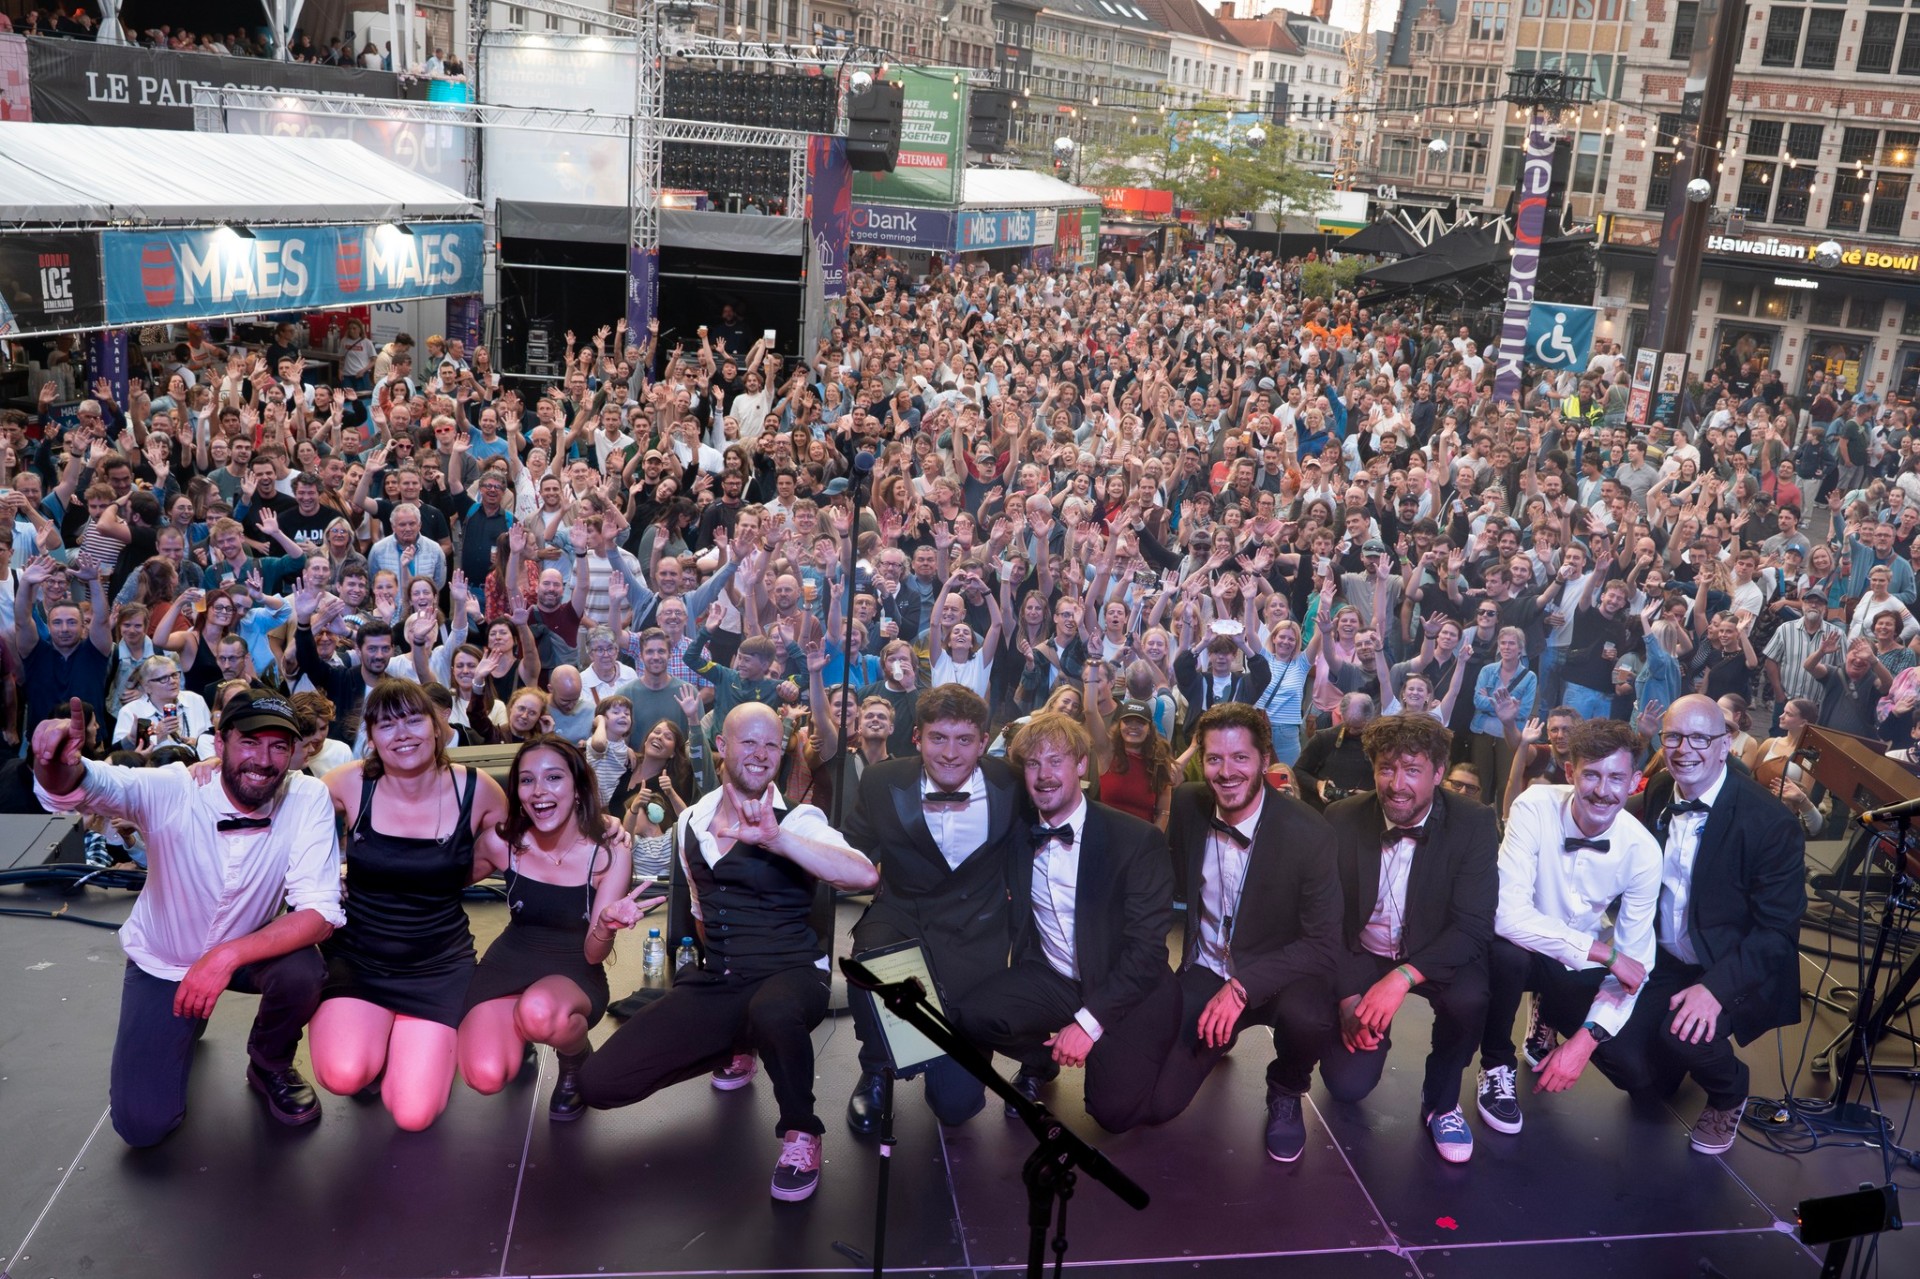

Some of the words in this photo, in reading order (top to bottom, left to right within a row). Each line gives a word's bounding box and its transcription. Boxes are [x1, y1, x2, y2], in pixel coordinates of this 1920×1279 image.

[85, 72, 130, 104] LE
[902, 109, 937, 118] EESTEN
[939, 111, 948, 119] IS
[903, 100, 929, 108] NTSE
[901, 132, 947, 142] OGETHER
[856, 231, 878, 240] goed
[880, 233, 917, 244] omringd
[970, 216, 997, 245] MAES
[1007, 215, 1031, 242] MAES
[38, 253, 62, 268] BORN
[1707, 235, 1806, 259] Hawaiian
[1864, 251, 1920, 271] Bowl
[181, 237, 309, 305] MAES
[365, 233, 463, 292] MAES
[40, 267, 73, 300] ICE
[113, 337, 121, 374] CASH
[61, 405, 79, 417] MAE
[294, 529, 323, 541] ALDI
